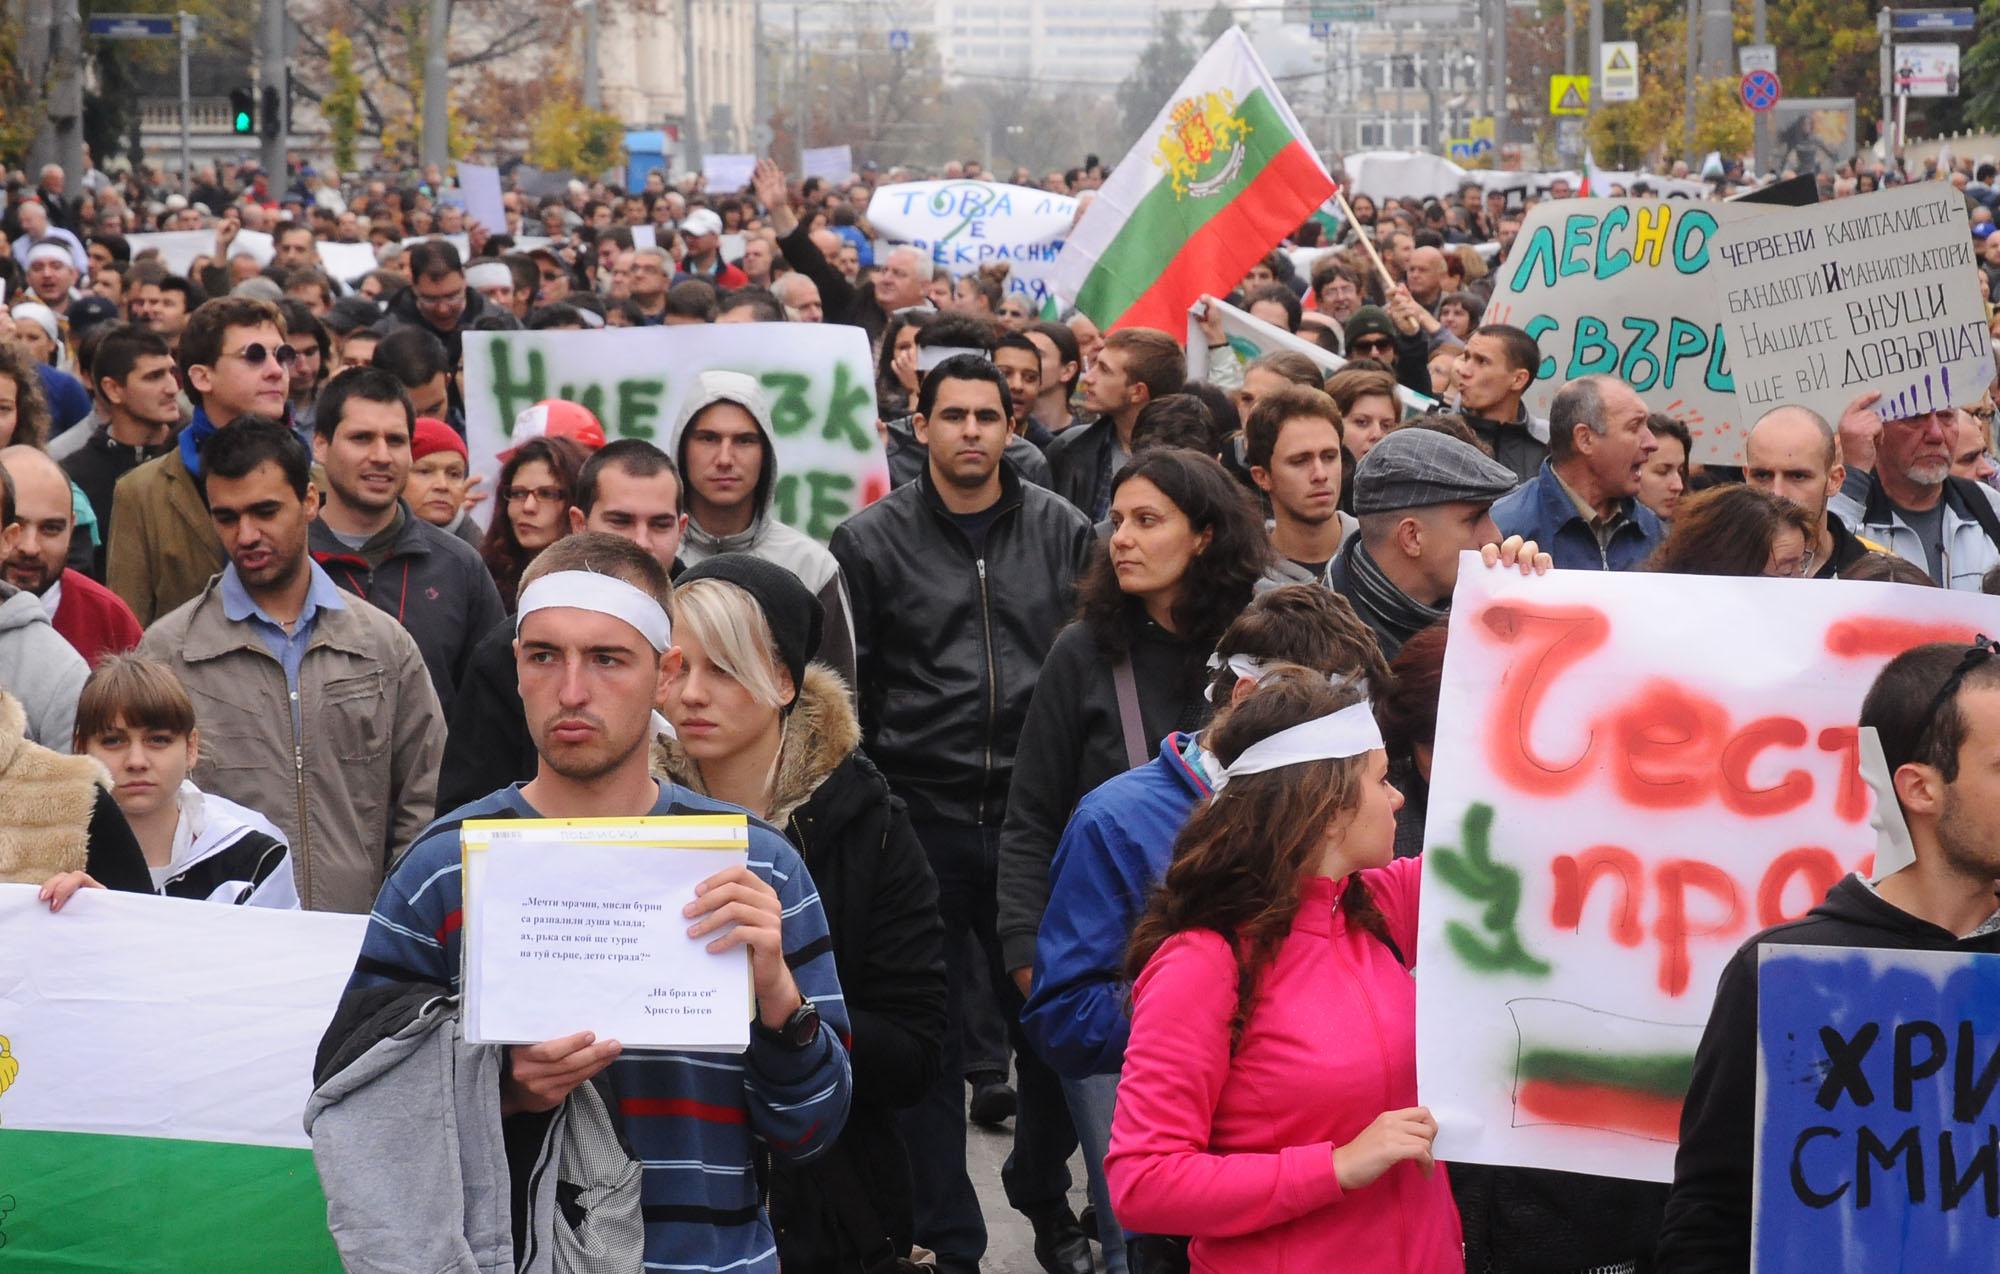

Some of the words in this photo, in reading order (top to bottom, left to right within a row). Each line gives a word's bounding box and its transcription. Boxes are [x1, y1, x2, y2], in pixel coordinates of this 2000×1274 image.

[891, 190, 1012, 217] ТОВА
[970, 221, 986, 238] Е
[1510, 203, 1719, 293] ЛЕСНО
[1720, 228, 1816, 267] ЧЕРВЕНИ
[1728, 271, 1823, 313] БАНДЮГИ
[1840, 242, 1971, 291] МАНИПУЛАТОРИ
[1846, 283, 1948, 336] ВНУЦИ
[1841, 321, 1988, 388] ДОВЪРШАТ
[1475, 597, 1874, 825] Чест
[585, 919, 610, 928] душа
[633, 902, 662, 912] бурни
[1548, 844, 1875, 1000] про
[533, 950, 550, 959] туй
[536, 934, 559, 943] ръка
[574, 934, 592, 943] кой
[594, 936, 608, 944] ще
[611, 937, 638, 946] турне
[669, 988, 698, 999] брата
[644, 1005, 680, 1016] Христо
[683, 1006, 712, 1015] Ботев
[1790, 1124, 2000, 1219] СМИ
